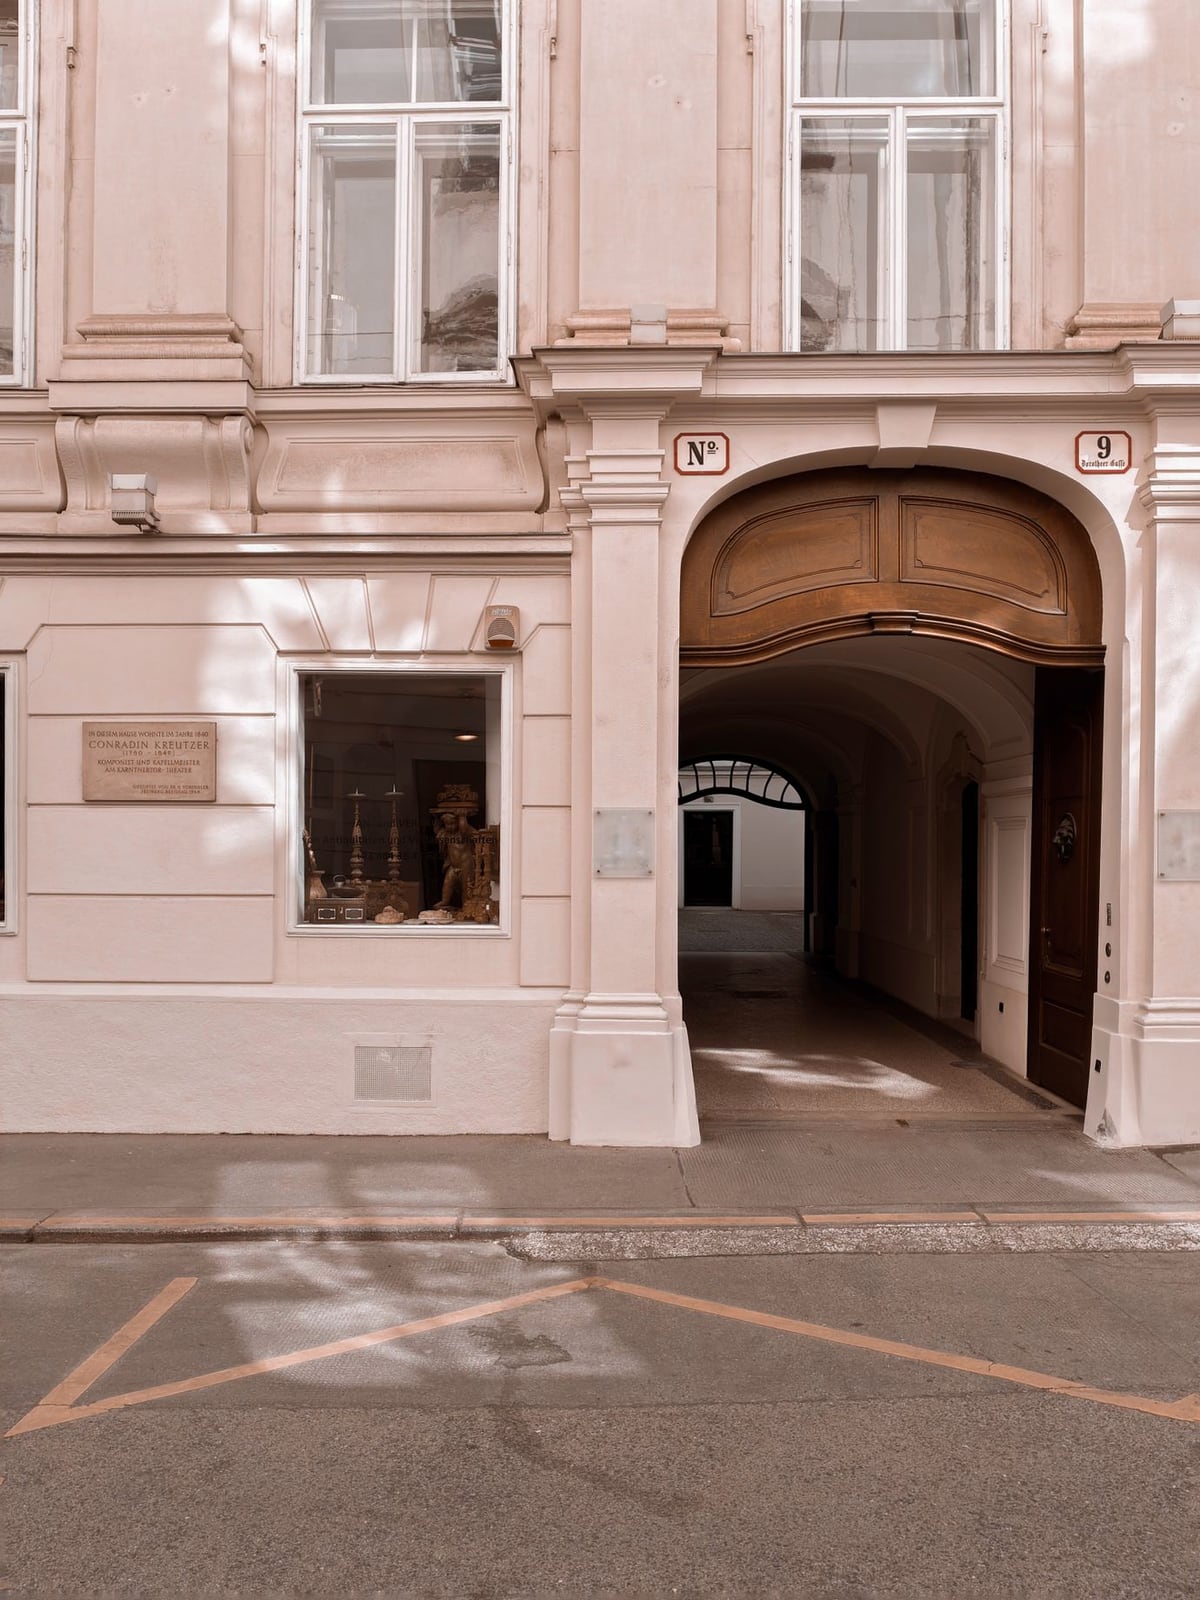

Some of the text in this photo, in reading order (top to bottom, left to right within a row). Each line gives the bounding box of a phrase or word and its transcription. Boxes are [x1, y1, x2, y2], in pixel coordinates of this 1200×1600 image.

[1097, 435, 1111, 459] 9
[88, 740, 209, 750] CONRADIN KREUTZER
